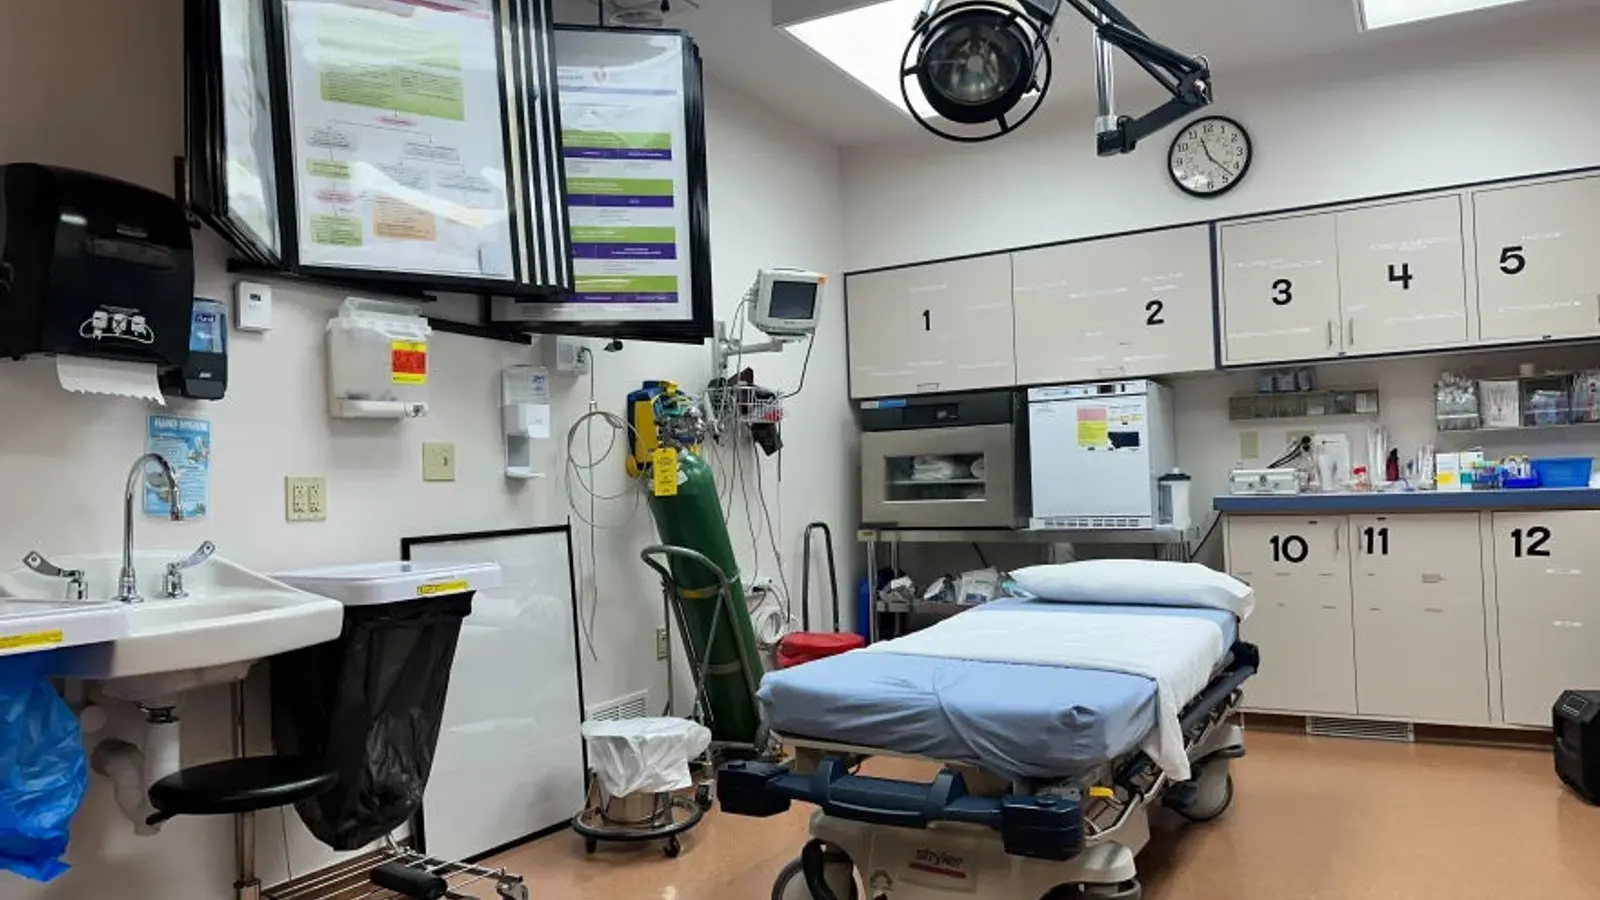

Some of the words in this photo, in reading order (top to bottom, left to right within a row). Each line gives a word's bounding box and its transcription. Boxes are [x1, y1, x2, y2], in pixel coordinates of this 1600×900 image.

[1203, 124, 1214, 134] 12
[1220, 125, 1225, 134] 1
[1188, 130, 1198, 140] 11
[1231, 133, 1238, 143] 2
[1177, 143, 1189, 152] 10
[1236, 147, 1243, 156] 3
[1176, 157, 1183, 167] 9
[1233, 161, 1239, 170] 4
[1222, 175, 1229, 184] 5
[1207, 181, 1214, 190] 6
[1500, 245, 1526, 275] 5
[1388, 263, 1413, 290] 4
[1271, 278, 1293, 305] 3
[1145, 300, 1164, 326] 2
[922, 309, 931, 331] 1
[1363, 526, 1389, 556] 11
[1510, 526, 1551, 558] 12
[1269, 534, 1309, 564] 10
